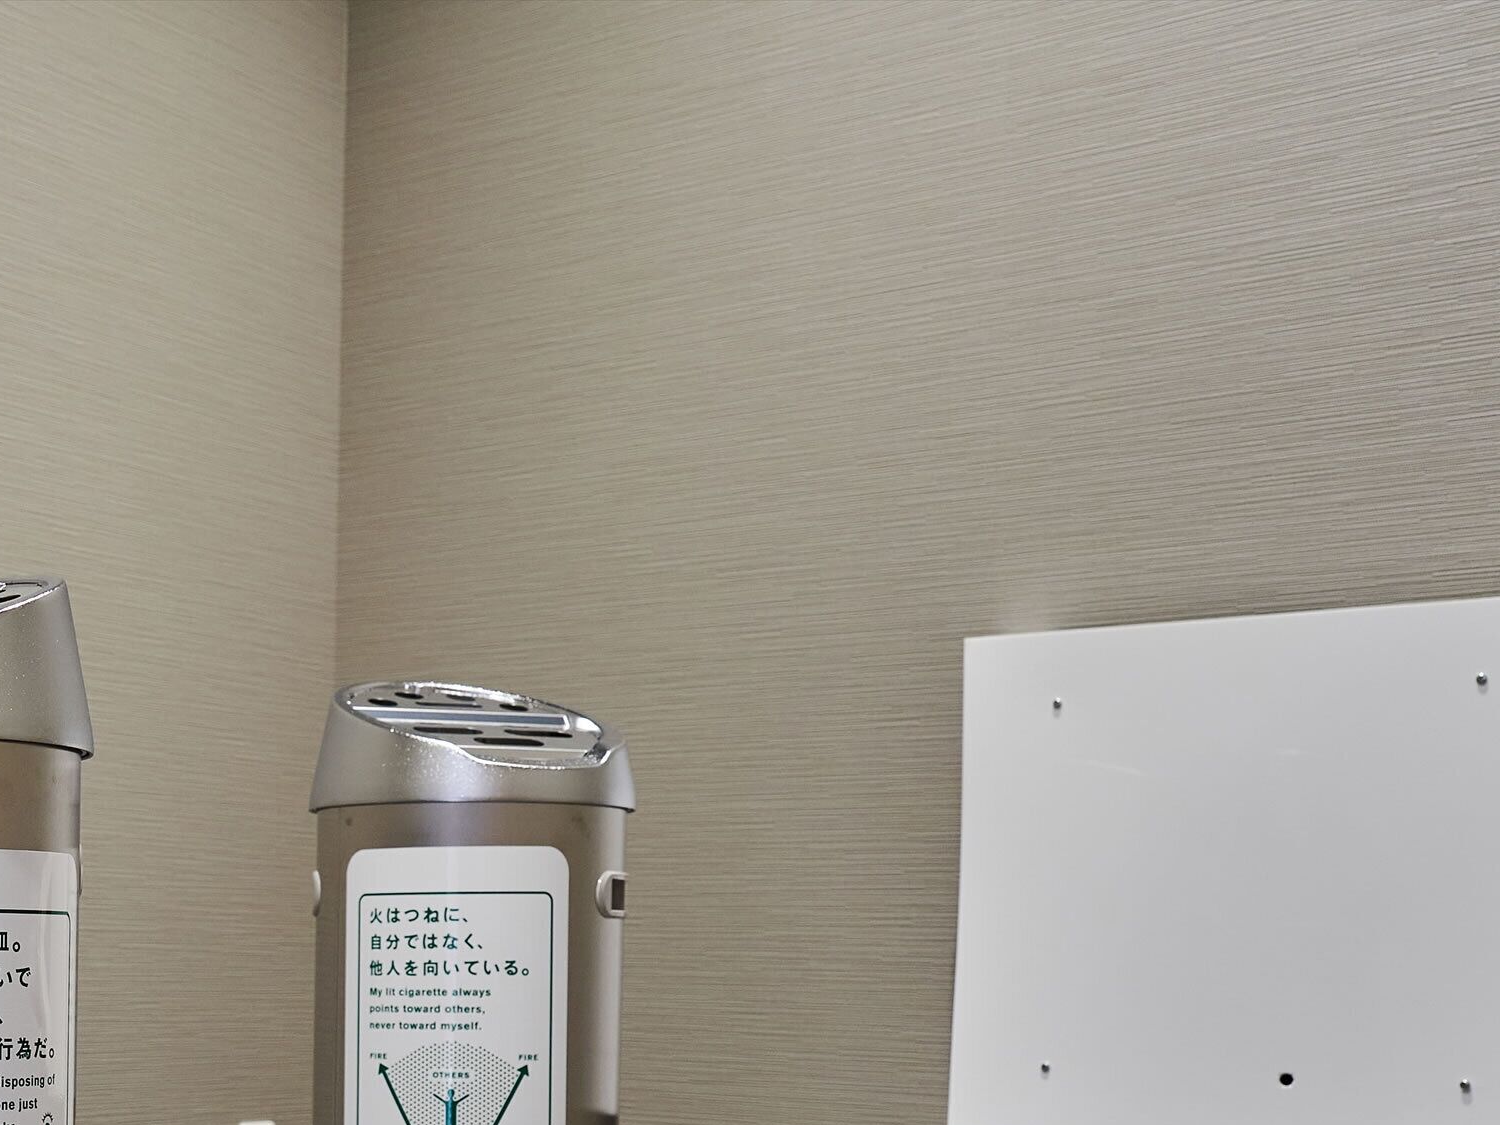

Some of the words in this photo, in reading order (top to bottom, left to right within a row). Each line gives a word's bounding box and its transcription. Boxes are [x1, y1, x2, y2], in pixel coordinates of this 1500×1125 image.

[370, 907, 468, 924] 火はつねに、
[370, 934, 483, 950] 自分ではなく、
[370, 960, 529, 976] 他人を向いている。
[370, 988, 382, 998] My
[386, 988, 395, 996] lit
[399, 988, 448, 998] cigarette
[452, 988, 491, 998] always
[370, 1005, 399, 1015] points
[403, 1005, 441, 1013] toward
[445, 1005, 485, 1014] others,
[370, 1022, 396, 1030] never
[399, 1022, 436, 1030] toward
[441, 1022, 482, 1032] myself.
[47, 1074, 55, 1085] of
[18, 1098, 37, 1112] just
